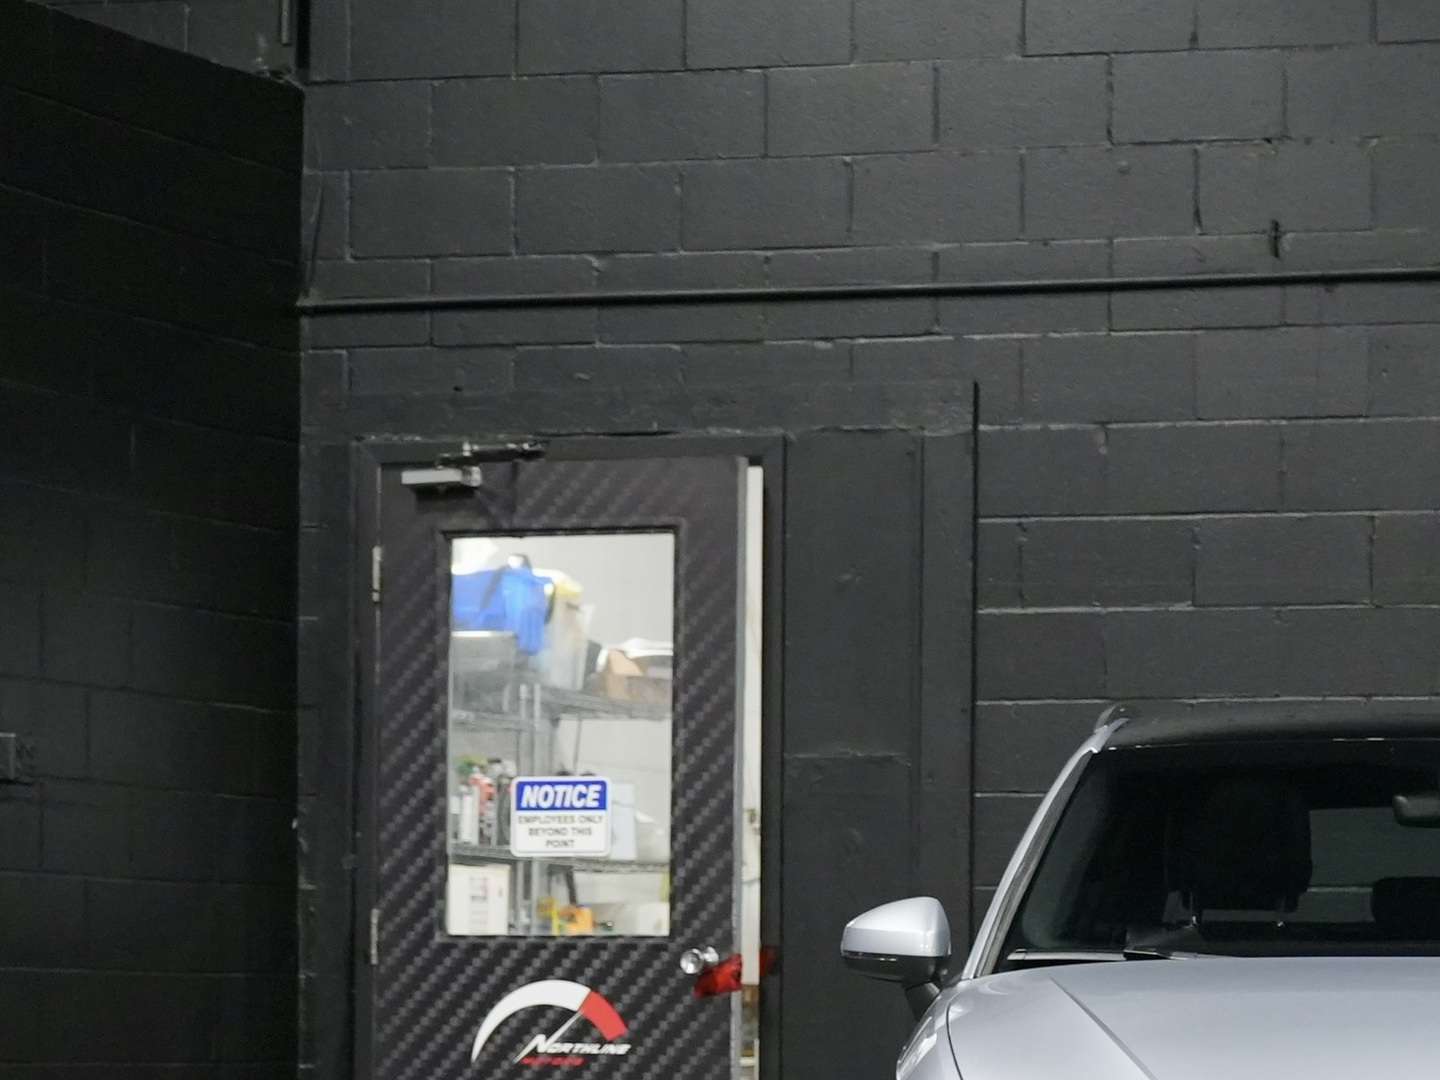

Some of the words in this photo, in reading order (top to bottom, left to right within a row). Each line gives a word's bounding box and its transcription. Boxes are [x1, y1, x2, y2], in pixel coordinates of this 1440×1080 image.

[520, 784, 602, 809] NOTICE
[518, 815, 576, 825] EMPLOYEES
[579, 815, 603, 825] ONLY
[528, 827, 569, 837] BEYOND
[571, 827, 592, 837] THIS
[545, 839, 575, 849] POINT
